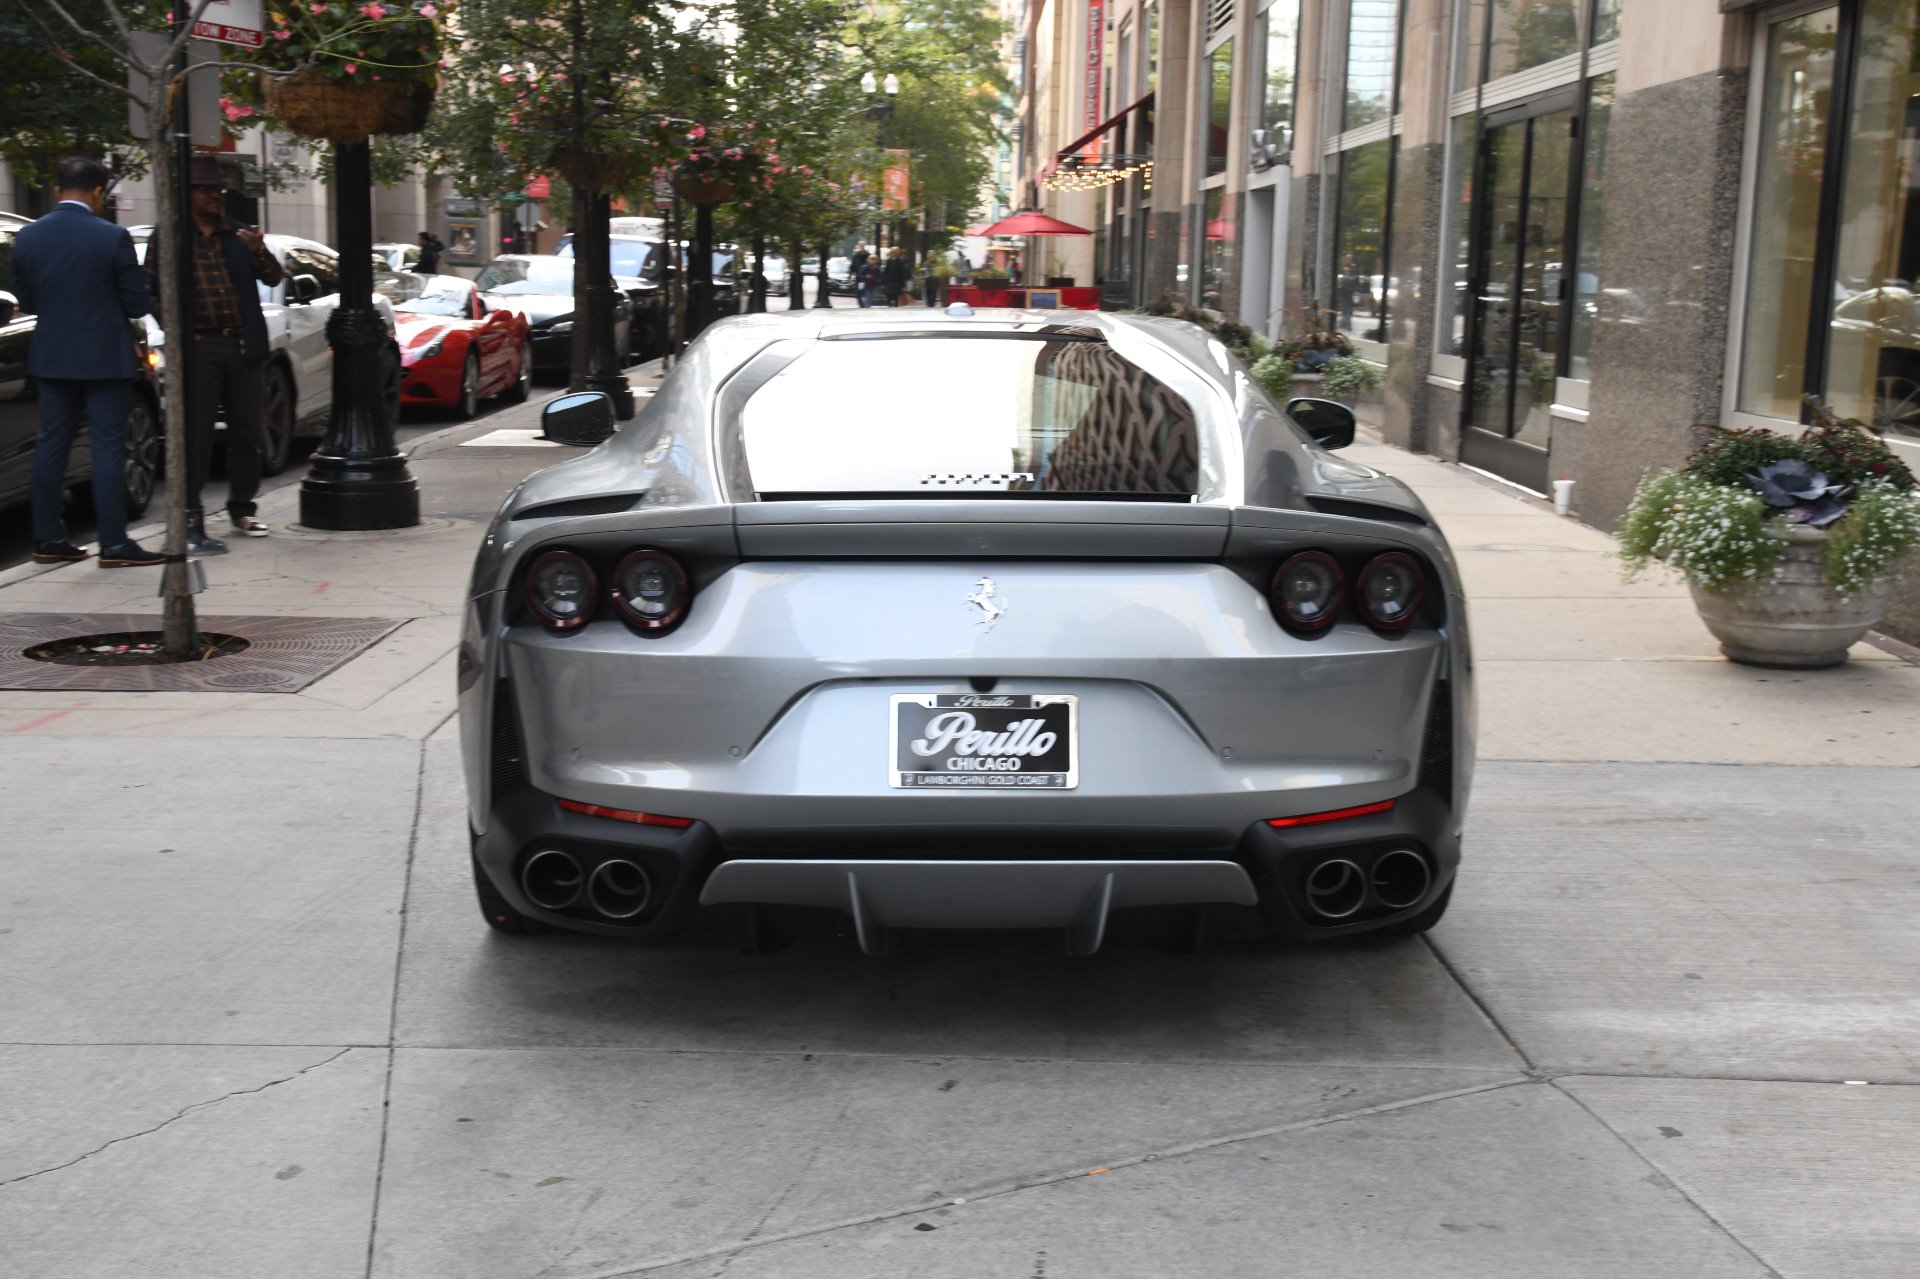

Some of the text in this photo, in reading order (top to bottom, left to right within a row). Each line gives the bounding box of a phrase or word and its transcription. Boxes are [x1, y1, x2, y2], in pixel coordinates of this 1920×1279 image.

[224, 26, 259, 45] ZONE
[911, 711, 1057, 757] Perillo
[946, 757, 1021, 771] CHICAGO
[917, 775, 1050, 785] LAMBORGHINI GOLD COAST
